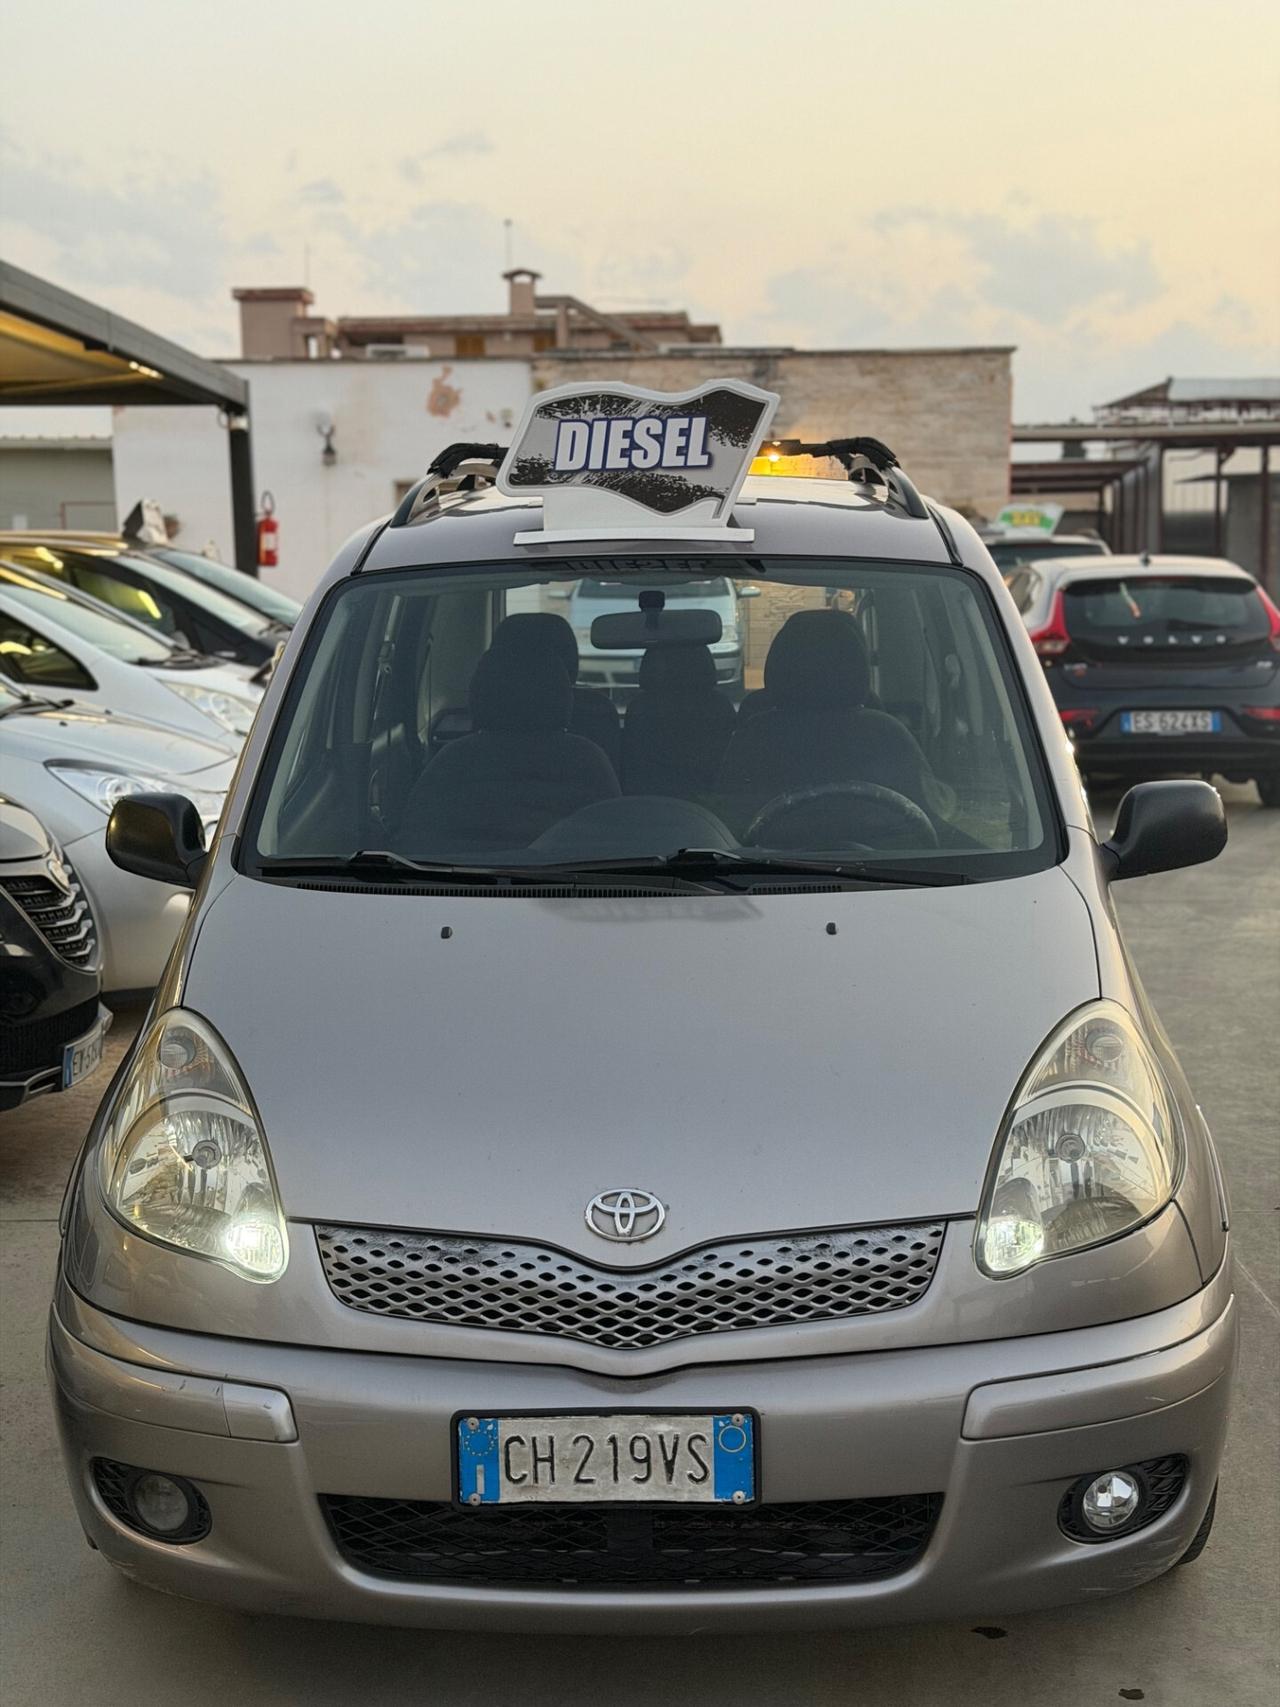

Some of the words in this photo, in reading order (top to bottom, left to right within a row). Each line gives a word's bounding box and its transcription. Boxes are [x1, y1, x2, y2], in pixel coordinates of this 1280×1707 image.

[554, 416, 711, 472] DIESEL
[1117, 635, 1227, 645] VOLVO
[504, 1434, 556, 1485] CH
[572, 1431, 711, 1485] 219VS
